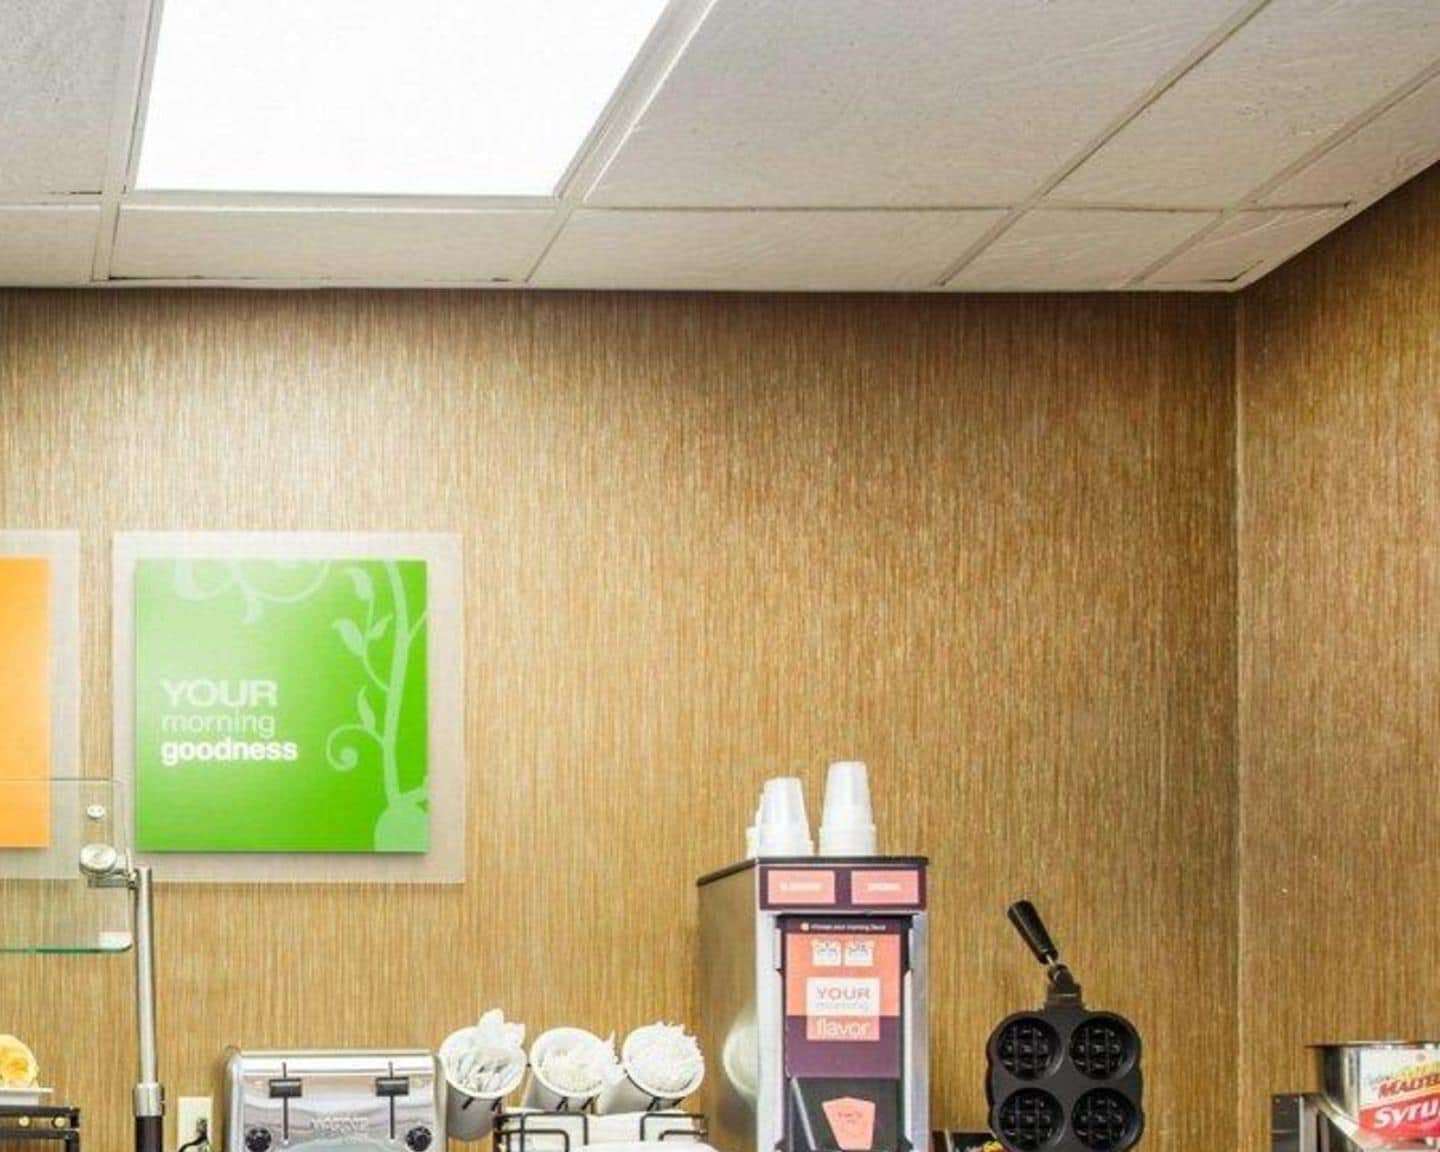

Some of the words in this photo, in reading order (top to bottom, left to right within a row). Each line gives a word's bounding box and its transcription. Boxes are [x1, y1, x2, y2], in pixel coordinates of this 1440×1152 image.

[160, 679, 278, 708] YOUR
[161, 708, 276, 740] morning
[161, 737, 299, 767] goodness
[815, 985, 871, 1001] YOUR
[815, 1018, 871, 1037] flavor
[1375, 1096, 1440, 1129] Syru
